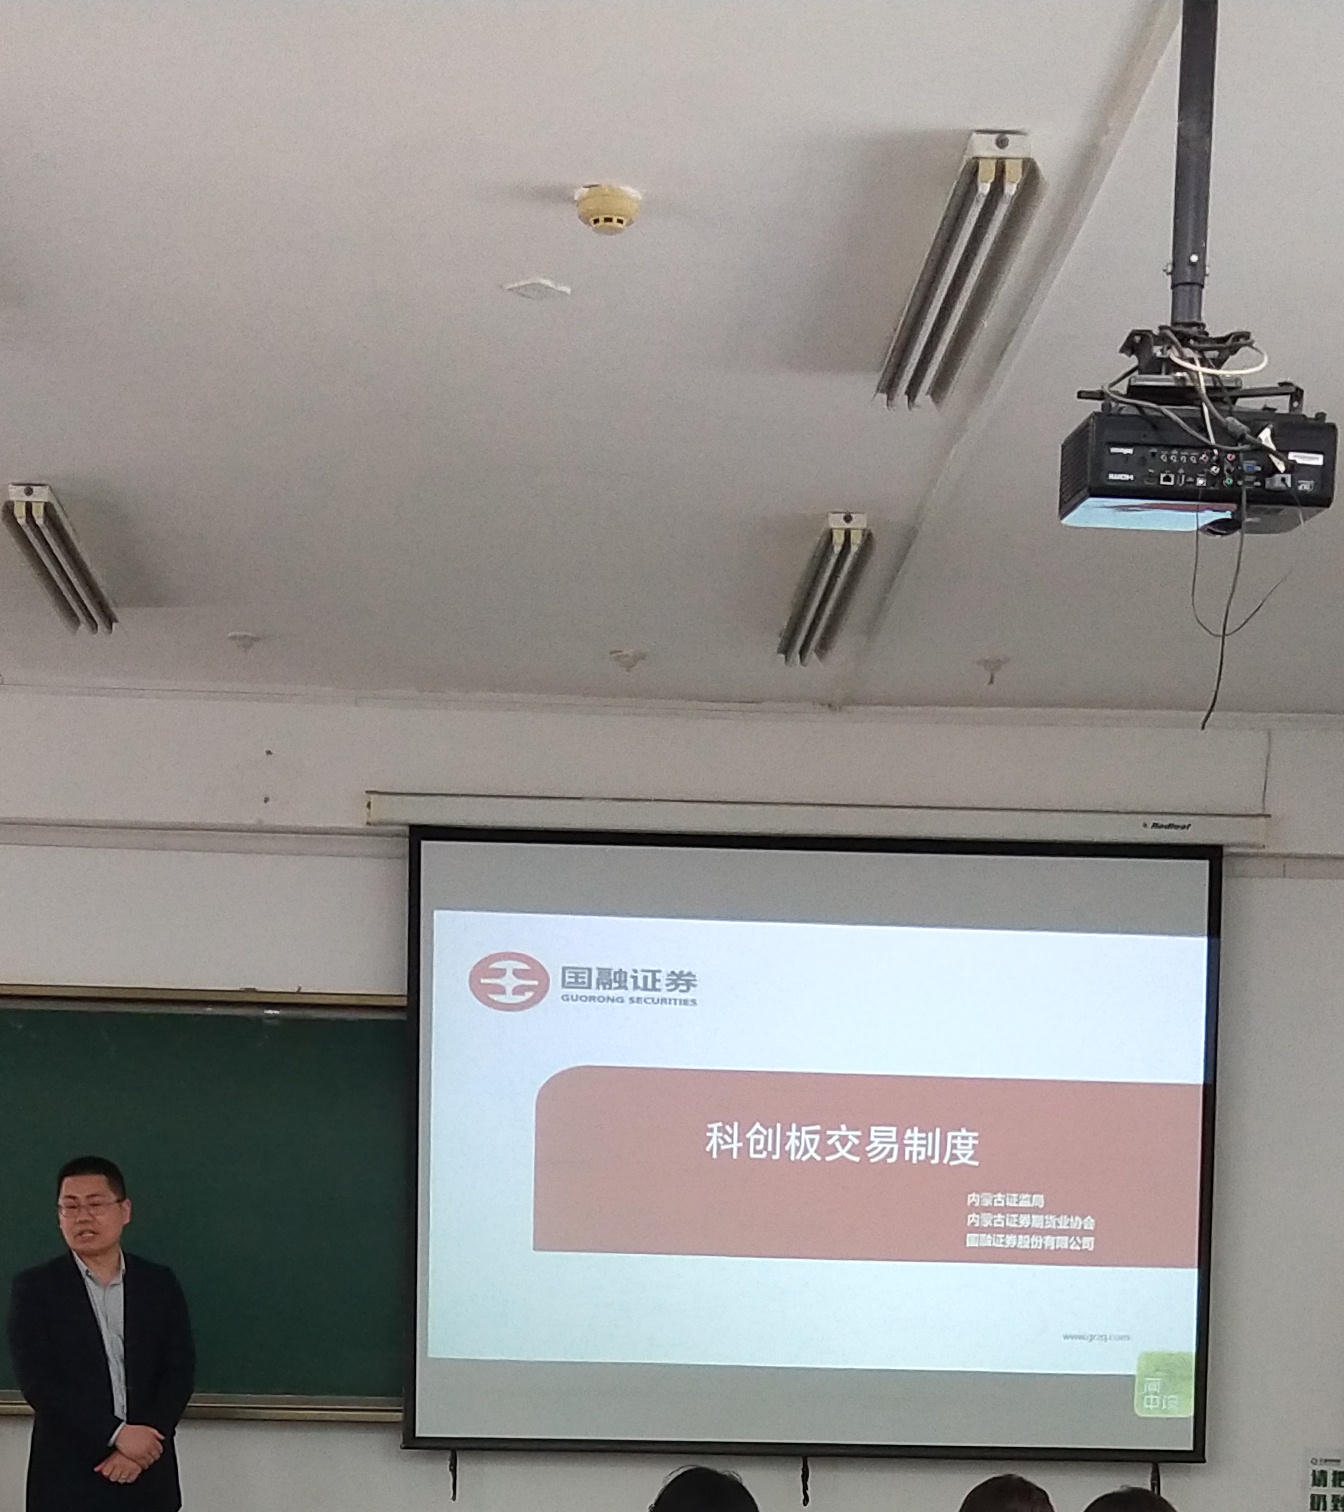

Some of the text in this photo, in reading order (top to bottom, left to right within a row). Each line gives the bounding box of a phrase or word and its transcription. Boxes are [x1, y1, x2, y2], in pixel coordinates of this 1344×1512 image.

[561, 966, 698, 994] 国融证券
[561, 994, 698, 1007] GUORONG SECURITIES
[705, 1121, 980, 1167] 科创板交易制度
[967, 1192, 1045, 1208] 内蒙古证监局
[966, 1233, 1095, 1251] 国融证券股份有限公司
